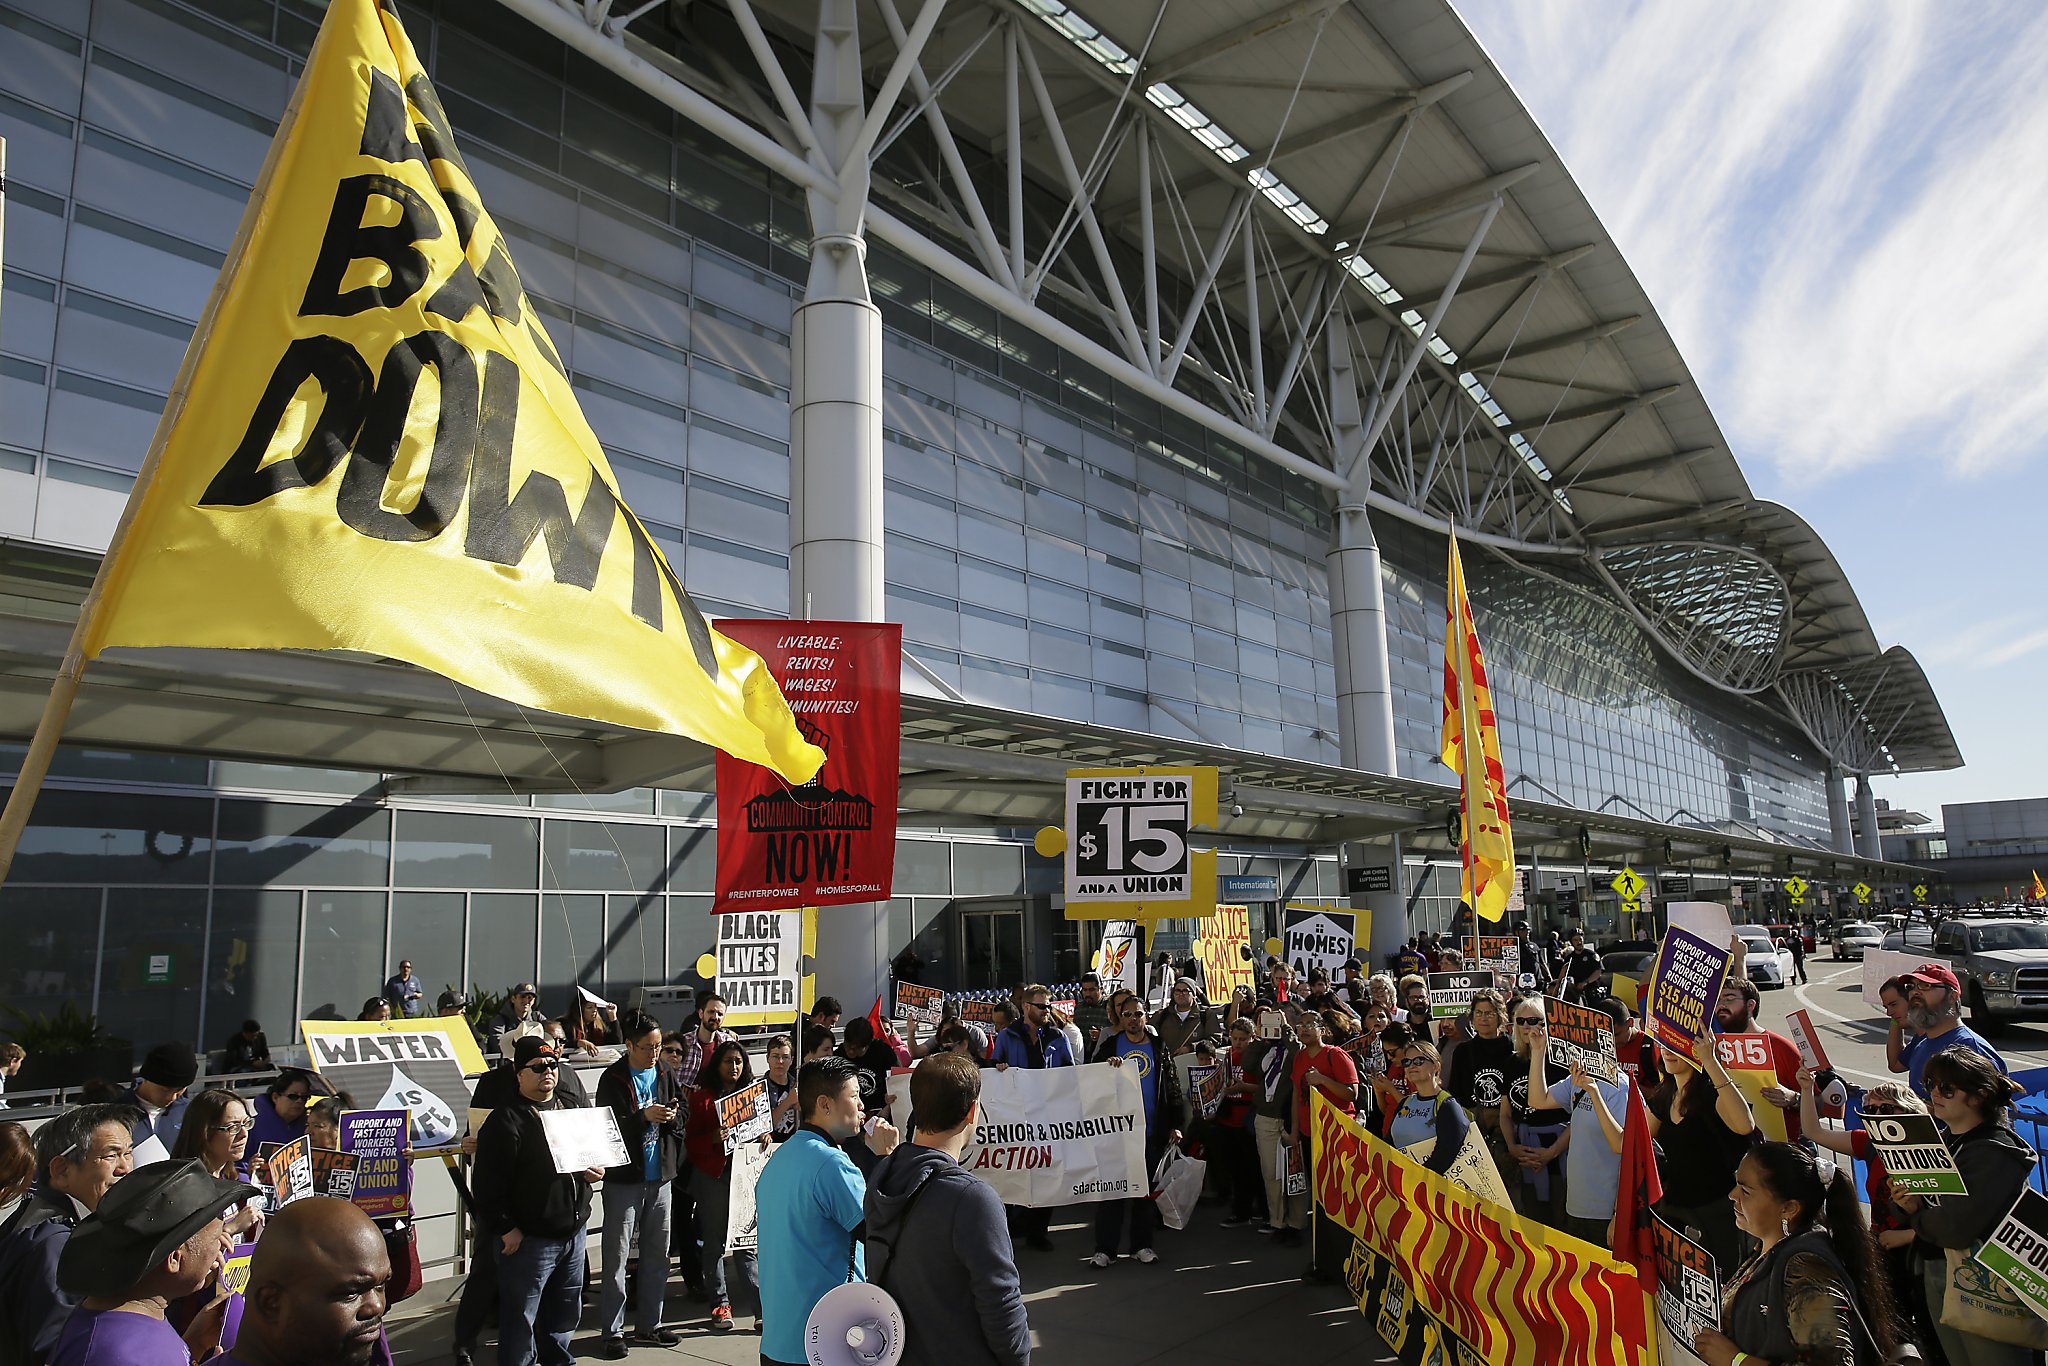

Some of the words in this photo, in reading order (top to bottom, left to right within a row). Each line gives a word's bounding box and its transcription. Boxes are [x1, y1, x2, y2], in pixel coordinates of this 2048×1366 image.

[776, 635, 843, 650] LIVEABLE:
[785, 656, 835, 671] RENTS!
[784, 678, 837, 692] WAGES!
[786, 700, 859, 714] MMUNITIES!
[1081, 781, 1147, 799] FIGHT
[1153, 781, 1187, 798] FOR
[751, 801, 818, 829] COMMUNITY
[818, 801, 870, 828] CONTROL
[1079, 805, 1185, 873] $15
[765, 832, 850, 884] NOW!
[728, 888, 799, 899] #RENTERPOWER
[815, 884, 881, 895] #HOMESFORALL
[1077, 884, 1105, 893] AND
[1107, 884, 1117, 893] A
[1123, 877, 1183, 893] UNION
[1229, 881, 1269, 889] International
[721, 914, 781, 940] BLACK
[1202, 908, 1248, 939] JUSTICE
[1205, 938, 1239, 970] CAN'T
[1291, 932, 1346, 955] HOMES
[1464, 937, 1515, 950] JSTICE
[1672, 937, 1706, 961] AIRPORT
[1704, 954, 1722, 970] AND
[723, 946, 776, 973] LIVES
[1673, 950, 1693, 967] FAST
[1694, 962, 1714, 978] FOOD
[1449, 977, 1471, 988] NO
[1665, 970, 1692, 993] RISING
[1692, 986, 1708, 1001] FOR
[1672, 961, 1709, 988] WORKERS
[720, 980, 794, 1006] MATTER
[899, 984, 941, 998] JUSTICE
[1659, 980, 1680, 1003] $15
[1680, 995, 1704, 1018] AND
[1444, 1006, 1472, 1016] #FightFo
[1548, 1001, 1610, 1031] JUSTICE
[1656, 997, 1663, 1013] A
[1666, 1007, 1700, 1035] UNION
[1570, 1027, 1594, 1044] WAIT!
[314, 1035, 448, 1064] WATER
[1717, 1038, 1767, 1065] $15
[395, 1090, 423, 1107] IS
[722, 1083, 763, 1120] JUSTICE
[349, 1118, 384, 1129] AIRPORT
[385, 1118, 403, 1127] AND
[353, 1129, 374, 1138] FAST
[375, 1128, 397, 1138] FOOD
[409, 1106, 451, 1141] IFE
[976, 1123, 1035, 1145] SENIOR
[1037, 1123, 1049, 1141] &
[1049, 1114, 1135, 1141] DISABILITY
[1862, 1118, 1907, 1142] NO
[354, 1138, 395, 1148] WORKERS
[381, 1148, 397, 1157] FOR
[373, 1159, 399, 1172] AND
[974, 1145, 1052, 1171] ACTION
[1464, 1149, 1484, 1168] up!
[359, 1174, 398, 1188] UNION
[1073, 1179, 1128, 1196] sdaction.org
[1651, 1217, 1708, 1276] STICE
[1996, 1220, 2048, 1273] DEPO
[1389, 1272, 1405, 1300] BLACK
[1685, 1267, 1700, 1281] FIGHT
[2008, 1265, 2048, 1304] #Figh
[1386, 1292, 1402, 1319] LIVES
[1685, 1278, 1712, 1308] $15
[1960, 1294, 1974, 1305] BIKE
[1975, 1300, 1984, 1309] TO
[1984, 1303, 2003, 1314] WORK
[1378, 1313, 1400, 1345] MATTER
